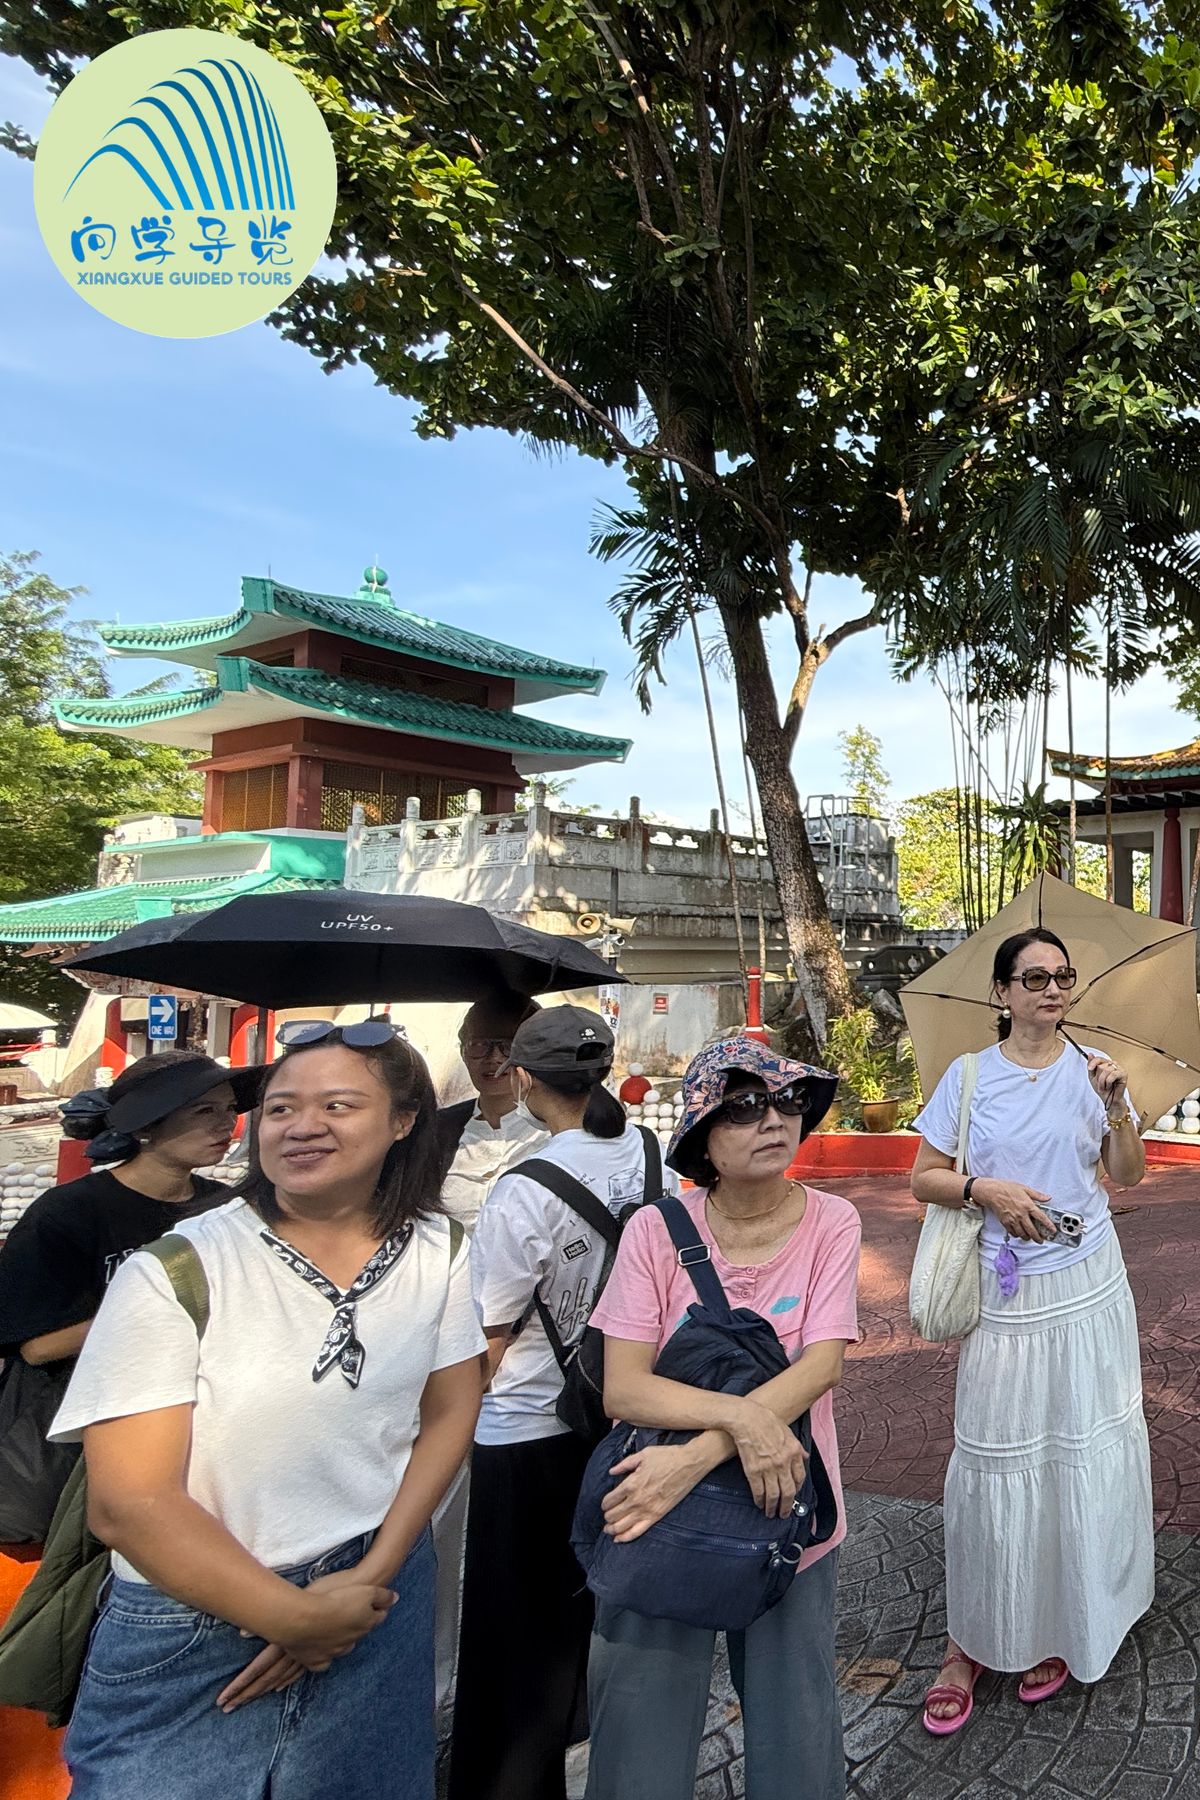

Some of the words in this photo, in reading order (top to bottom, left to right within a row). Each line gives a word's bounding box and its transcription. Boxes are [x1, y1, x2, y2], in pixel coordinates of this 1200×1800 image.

[346, 913, 374, 922] UV
[320, 921, 394, 931] UPF50+
[151, 1025, 162, 1035] ONE
